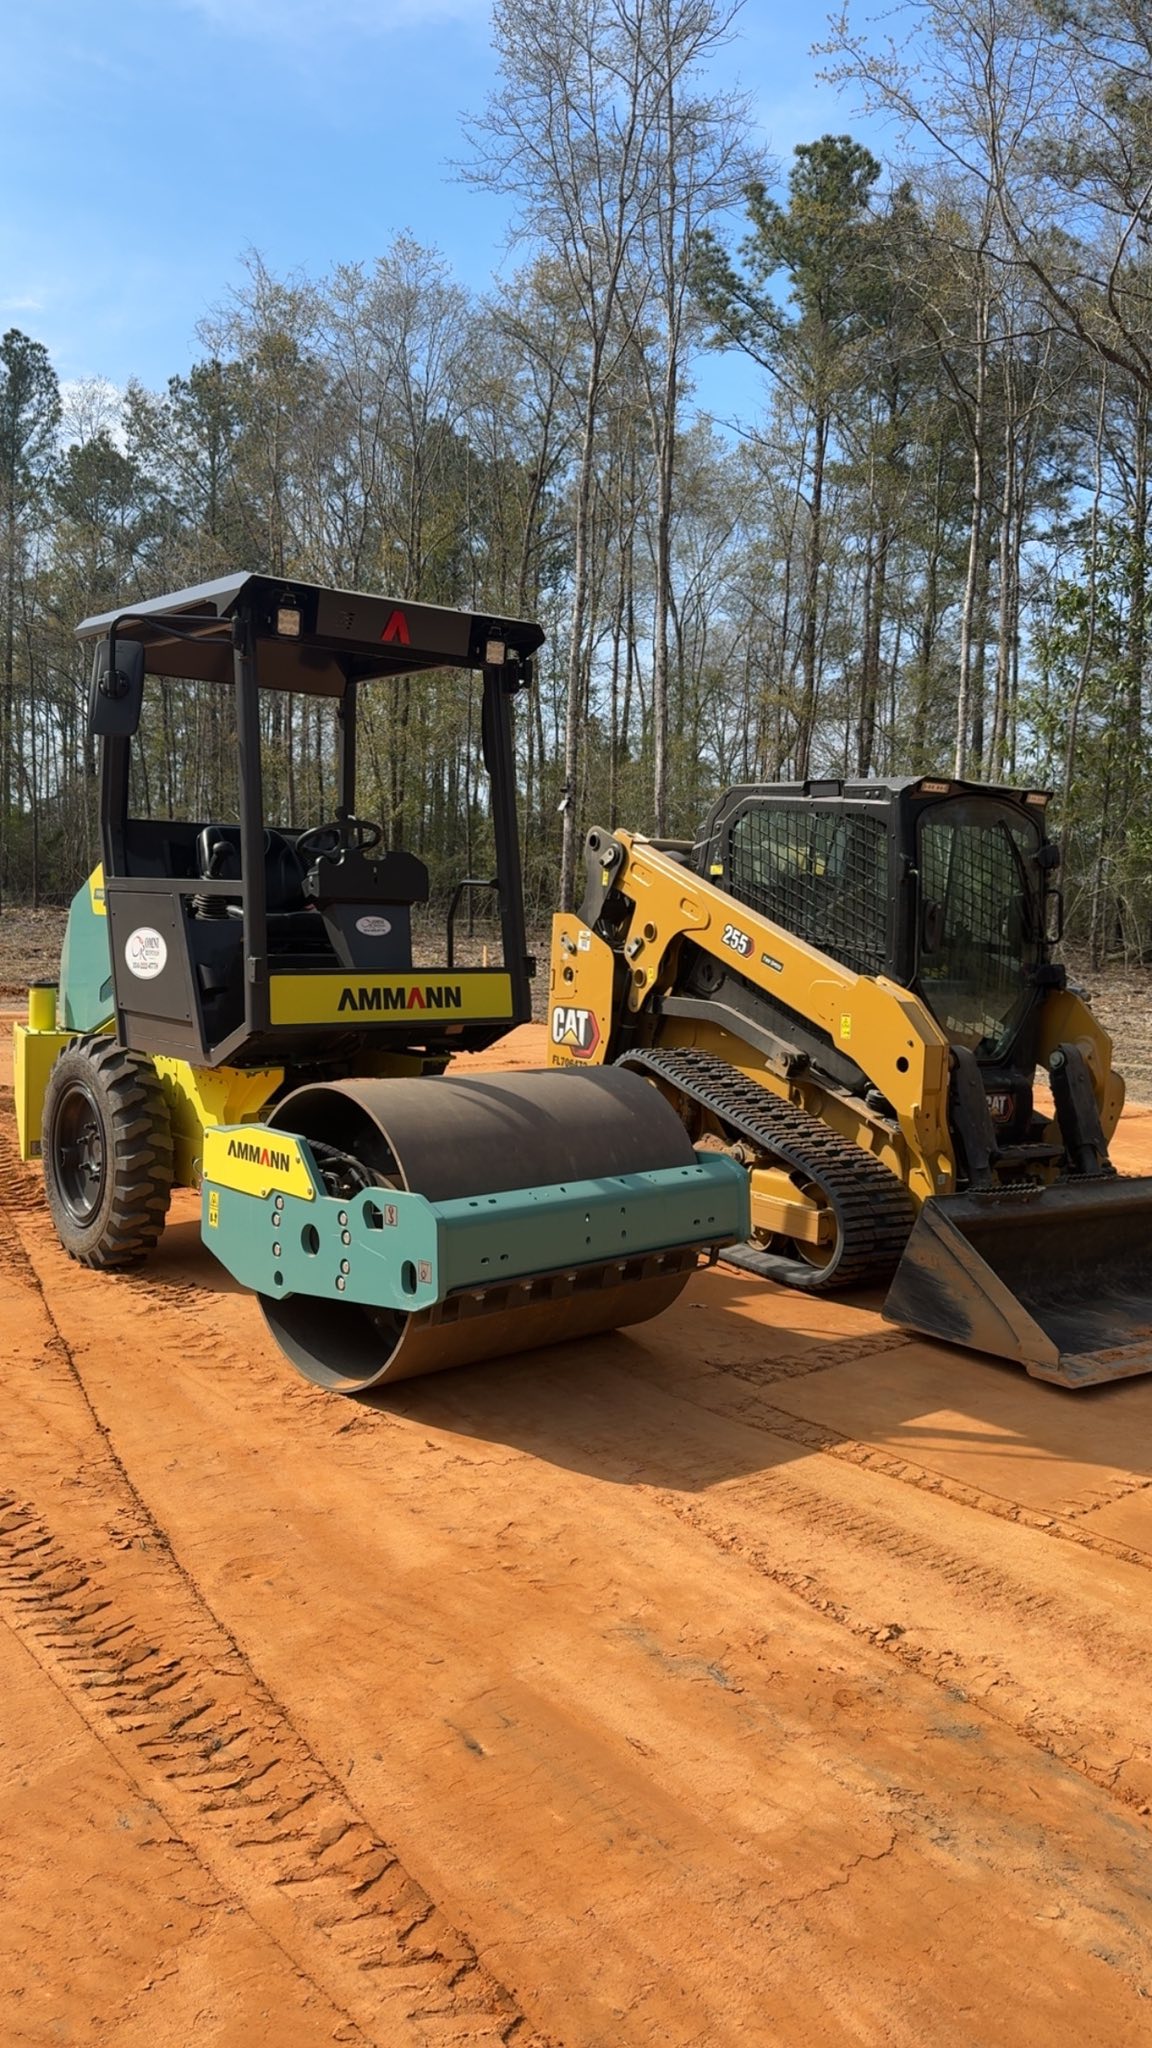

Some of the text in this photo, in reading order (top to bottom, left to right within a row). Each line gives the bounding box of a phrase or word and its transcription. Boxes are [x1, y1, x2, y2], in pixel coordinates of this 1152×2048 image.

[722, 924, 749, 954] 255
[337, 986, 462, 1011] AMMANN
[552, 1007, 589, 1046] CAT
[227, 1139, 290, 1173] AMMANN
